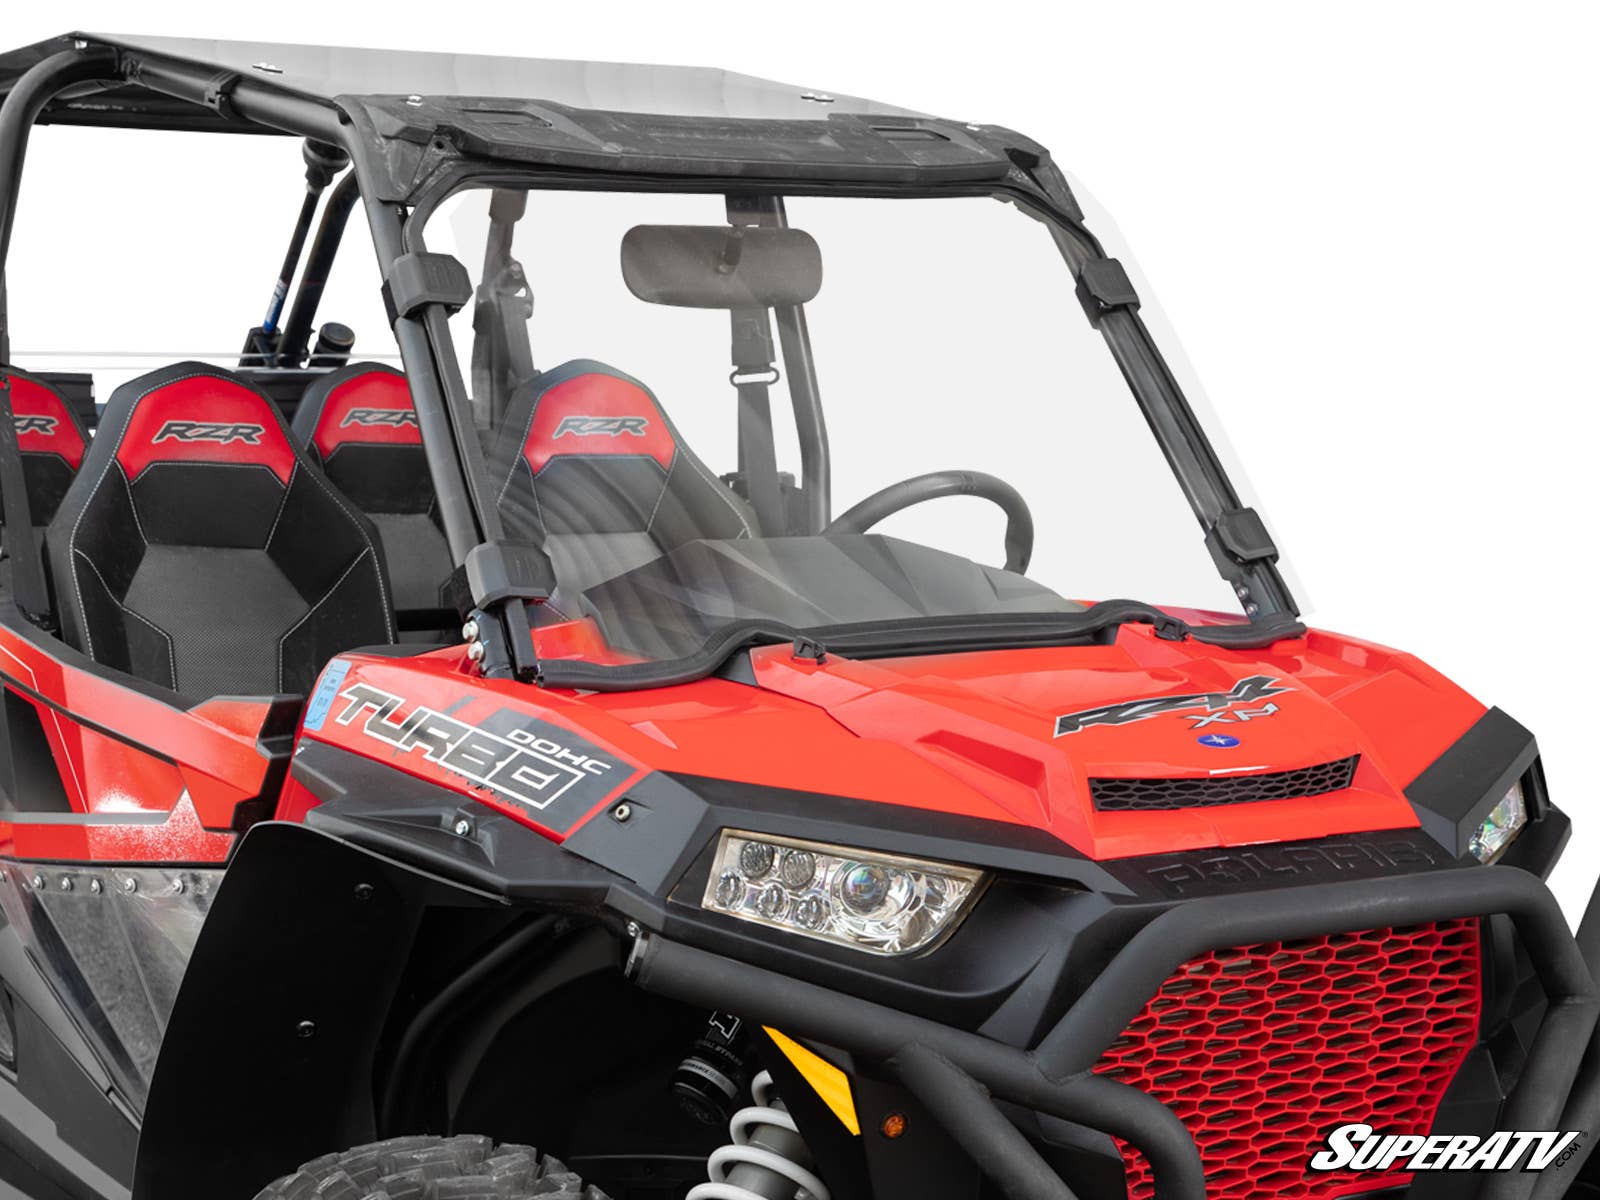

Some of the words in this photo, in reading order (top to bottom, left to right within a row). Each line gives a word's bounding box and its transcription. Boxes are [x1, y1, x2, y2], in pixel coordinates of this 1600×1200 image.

[152, 420, 265, 444] RZR
[552, 416, 649, 439] RZR
[1053, 675, 1296, 738] RZR
[335, 682, 587, 809] TURBO
[507, 729, 612, 776] DOHC
[1146, 840, 1436, 894] POLARIS
